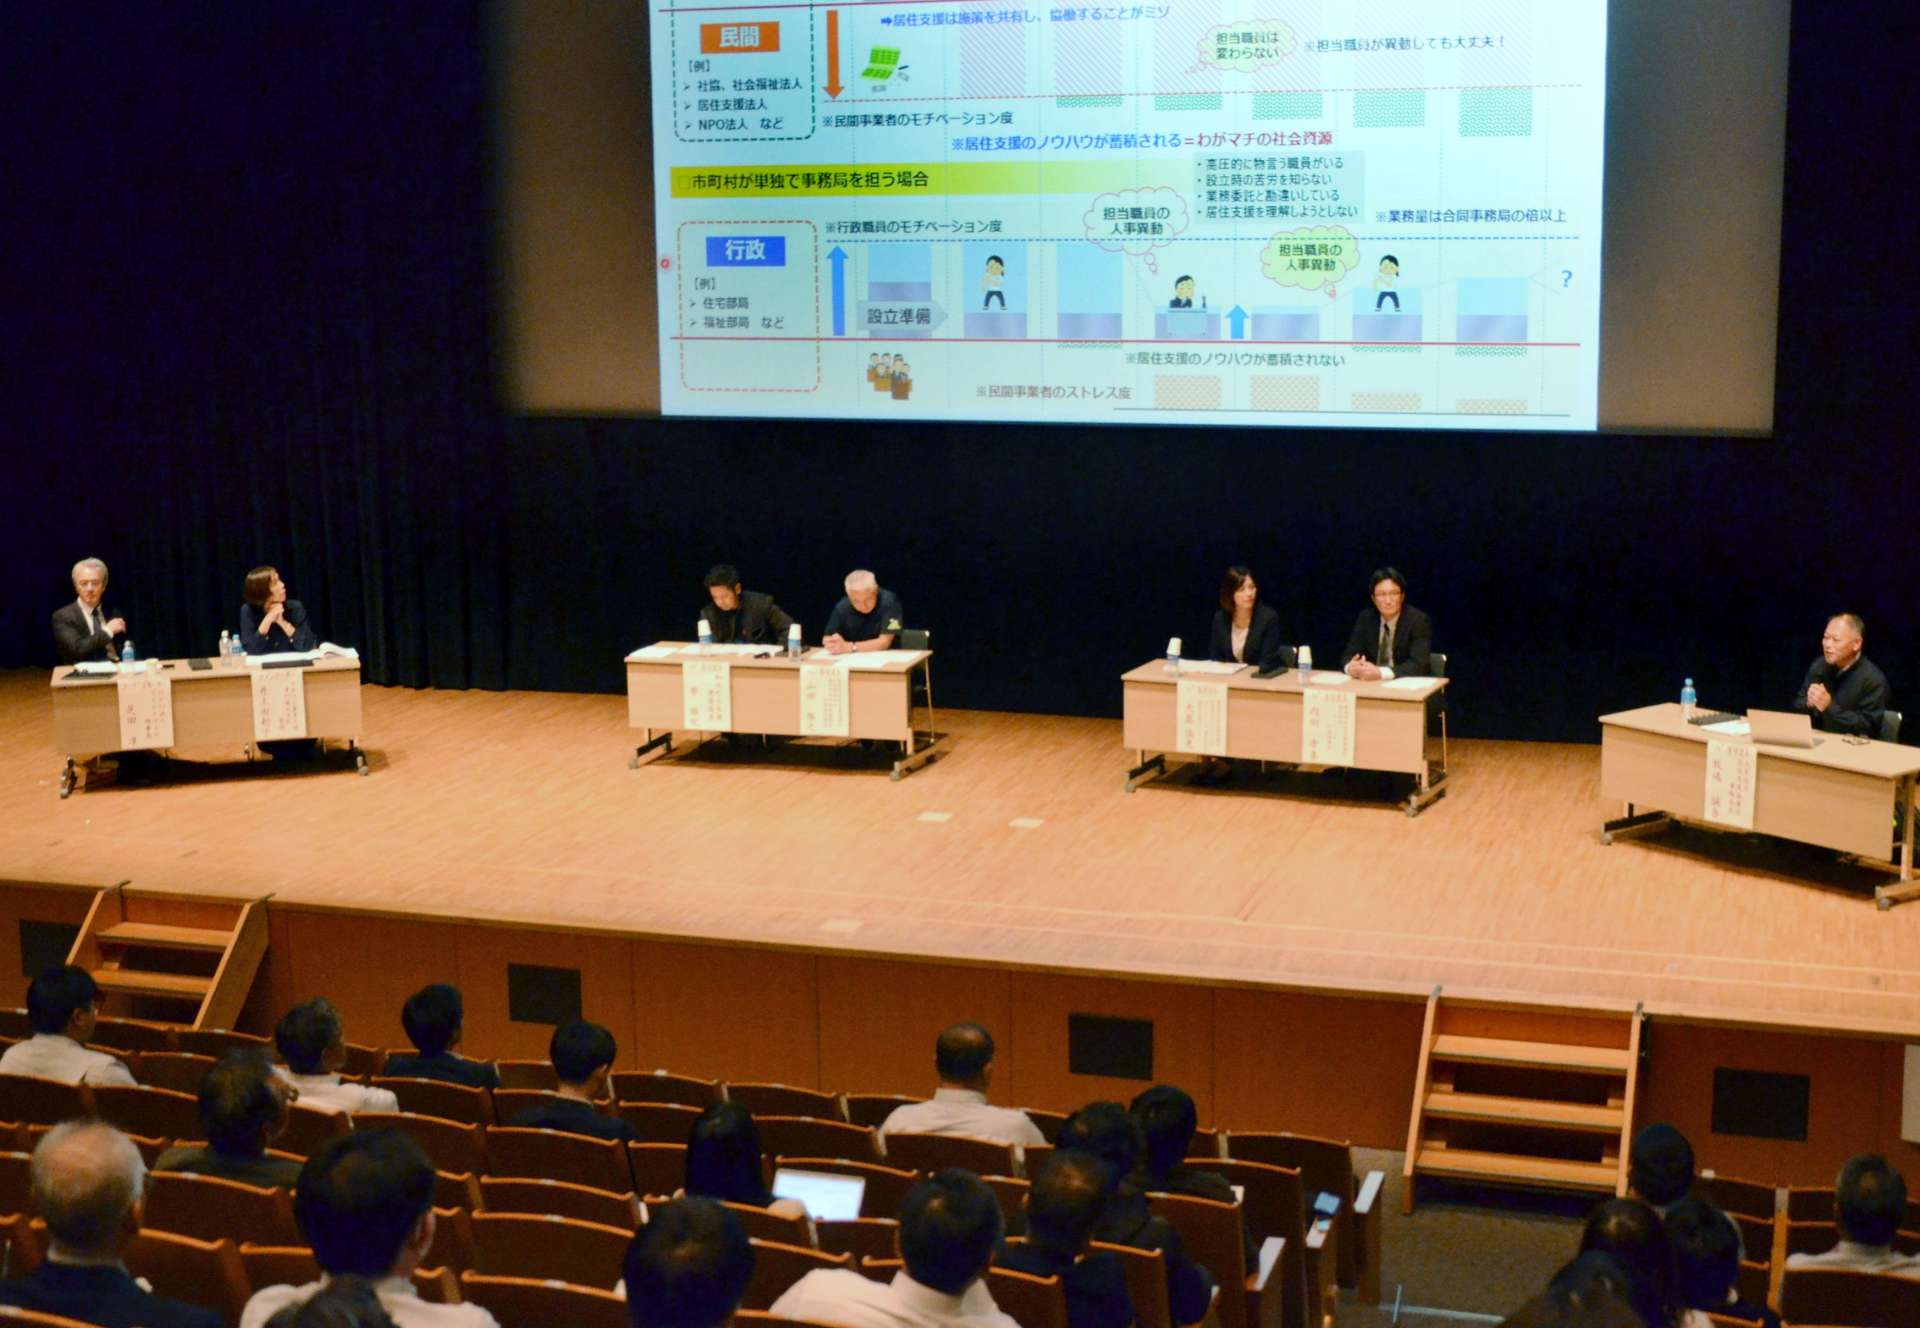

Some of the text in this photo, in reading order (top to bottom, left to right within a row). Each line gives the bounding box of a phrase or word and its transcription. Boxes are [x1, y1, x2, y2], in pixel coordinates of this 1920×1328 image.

[720, 26, 760, 48] 民間
[1216, 32, 1280, 45] 担当職員は
[1216, 47, 1280, 60] 変わらない
[698, 77, 803, 92] 社協、社会福祉法人
[697, 98, 768, 112] 居住支援法人
[698, 116, 784, 131] NPO法人 など
[1104, 207, 1170, 221] 担当職員の
[1111, 222, 1163, 236] 人事異動
[725, 239, 766, 261] 行政
[1279, 244, 1344, 257] 担当職員の
[1287, 259, 1337, 272] 人事異動
[703, 297, 750, 310] 住宅部局
[704, 316, 785, 330] 福祉部局 など
[867, 308, 931, 326] 設立準備
